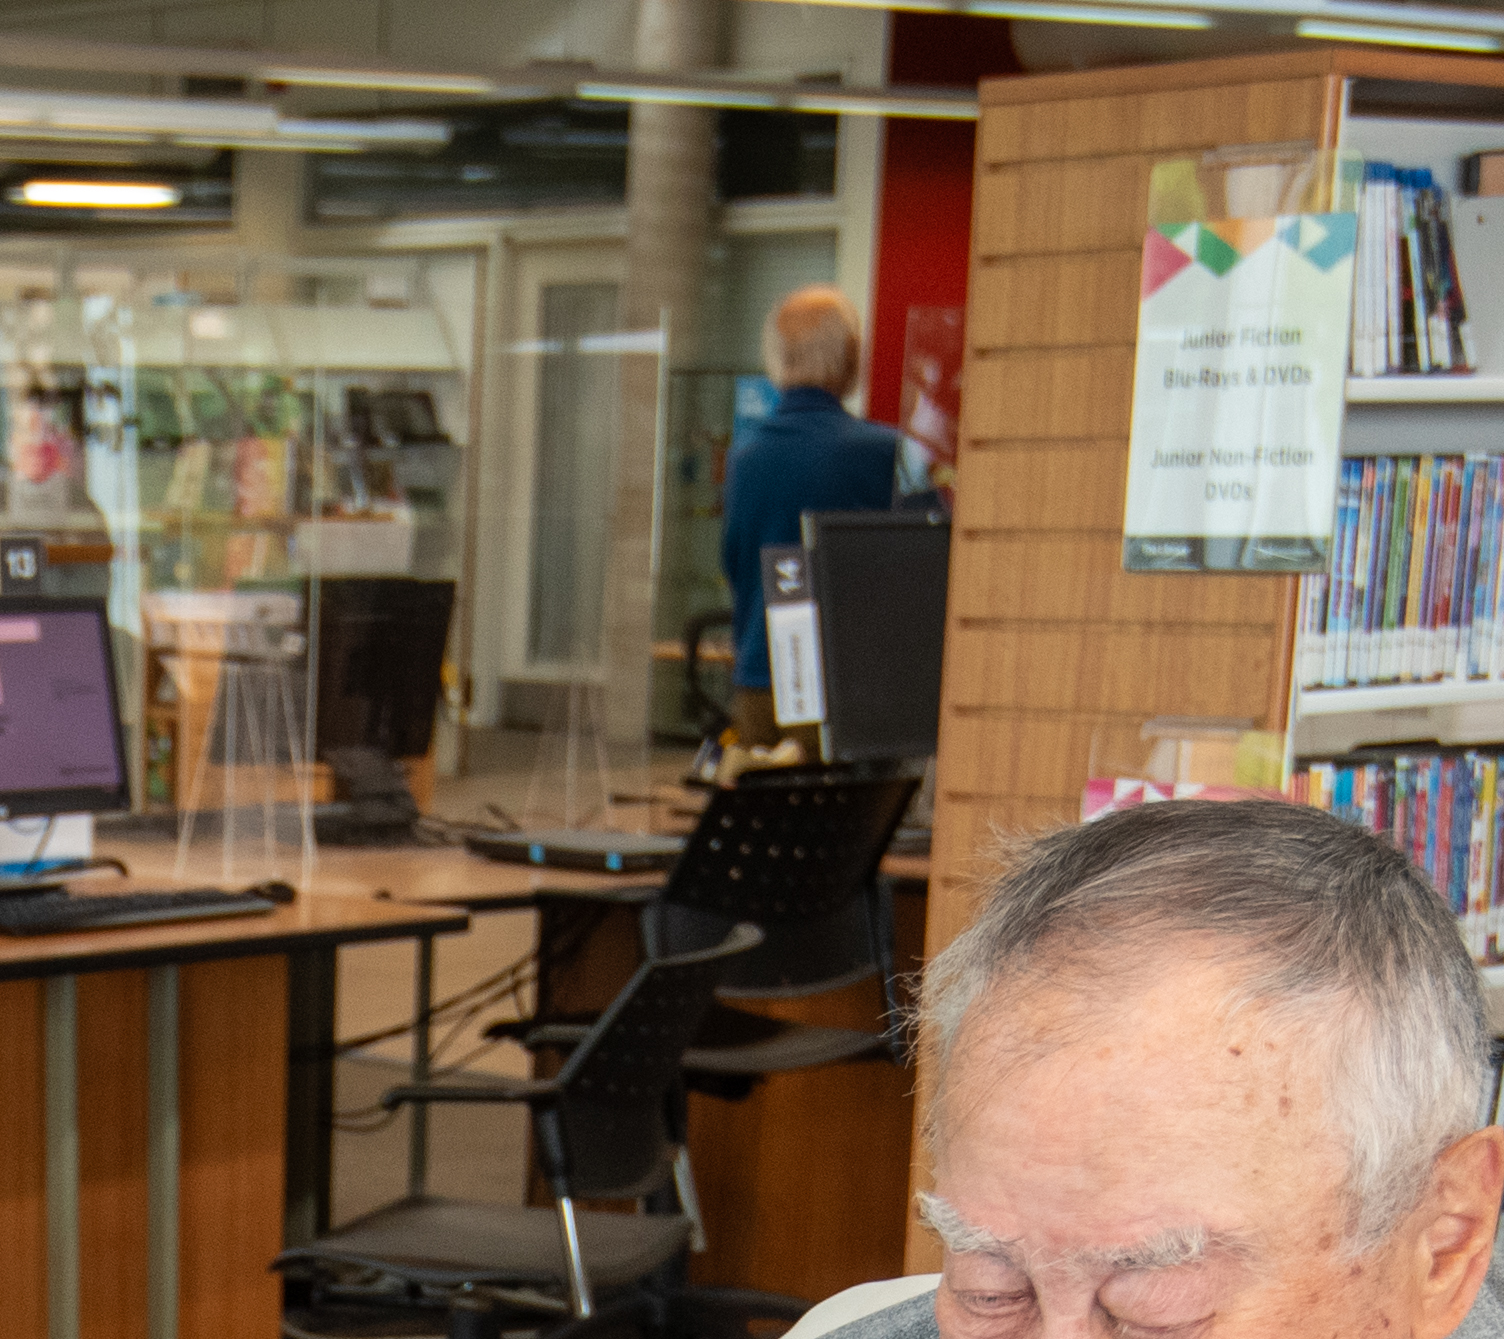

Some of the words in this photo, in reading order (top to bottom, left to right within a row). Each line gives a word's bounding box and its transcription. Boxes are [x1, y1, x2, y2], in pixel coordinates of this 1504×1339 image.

[1180, 328, 1234, 350] Junior
[1239, 326, 1302, 345] Fiction
[1163, 366, 1241, 390] Blu-Rays
[1263, 364, 1313, 386] DVDs
[1151, 448, 1205, 469] Junior
[1209, 446, 1314, 467] Non-Fiction
[1204, 481, 1254, 502] DVDs
